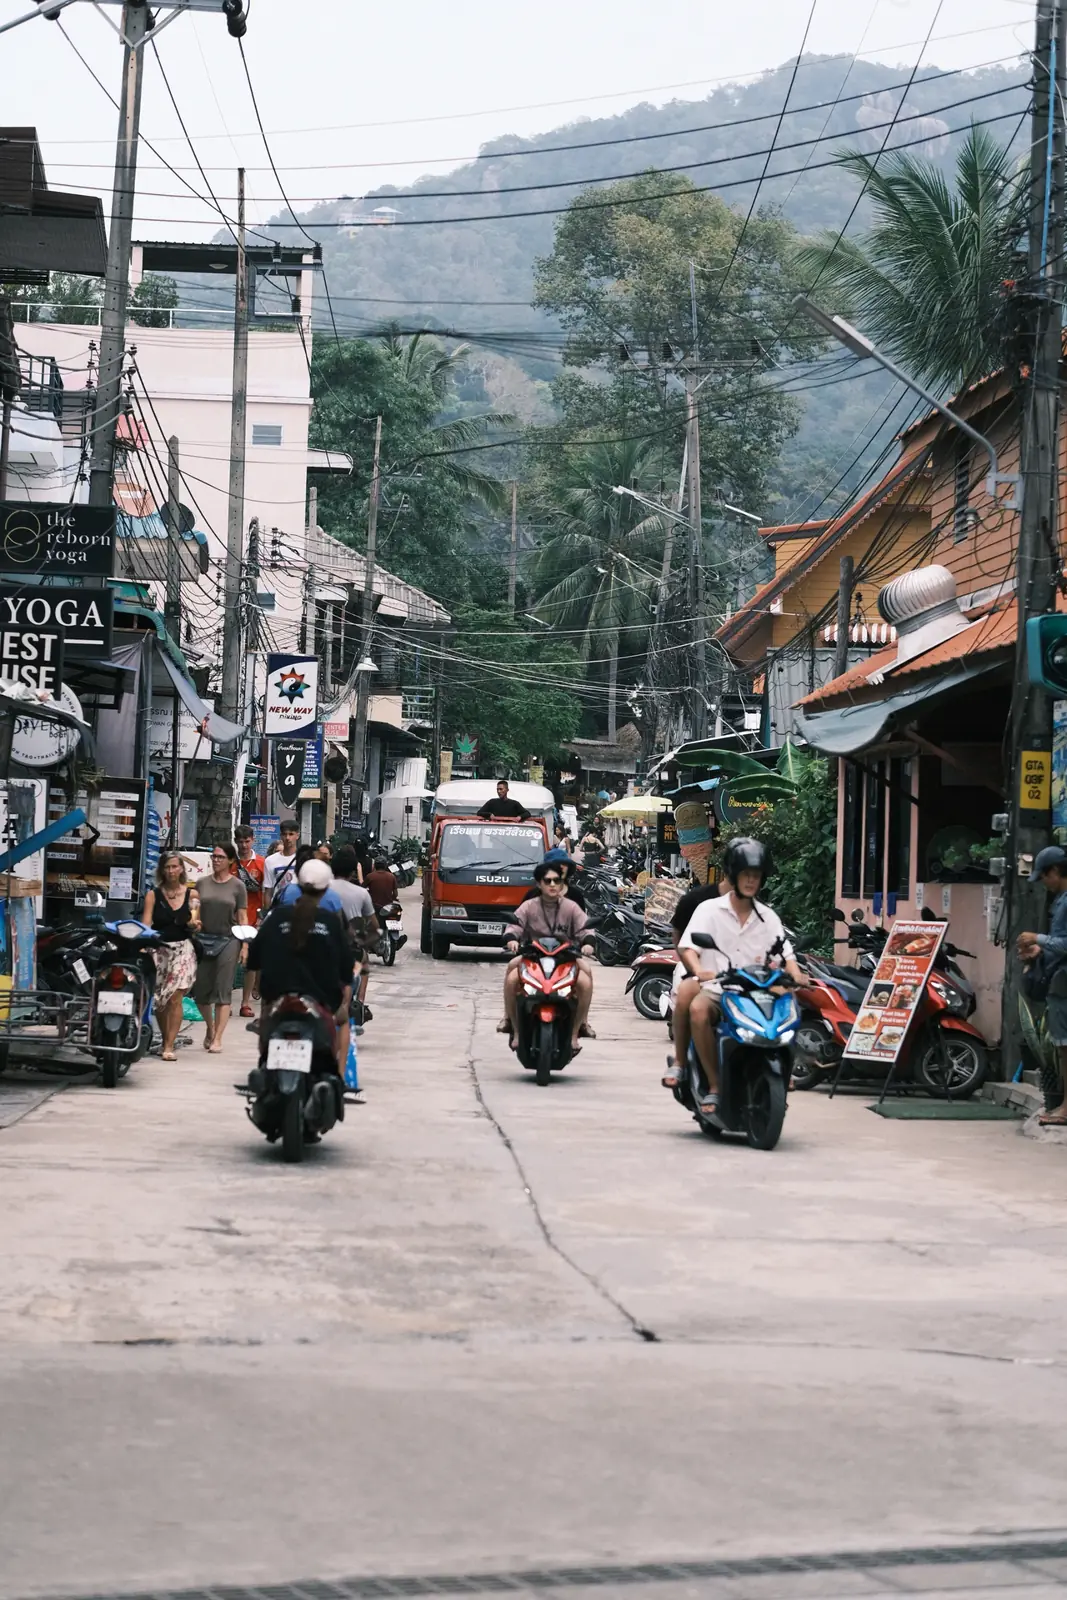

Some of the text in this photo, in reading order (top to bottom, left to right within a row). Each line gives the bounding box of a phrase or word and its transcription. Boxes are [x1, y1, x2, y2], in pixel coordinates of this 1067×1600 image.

[47, 511, 76, 527] the
[47, 529, 111, 546] reborn
[46, 549, 87, 564] yoga
[3, 597, 105, 628] YOGA
[0, 631, 58, 662] EST
[268, 706, 313, 715] NEW WAY
[475, 875, 510, 883] ISUZU
